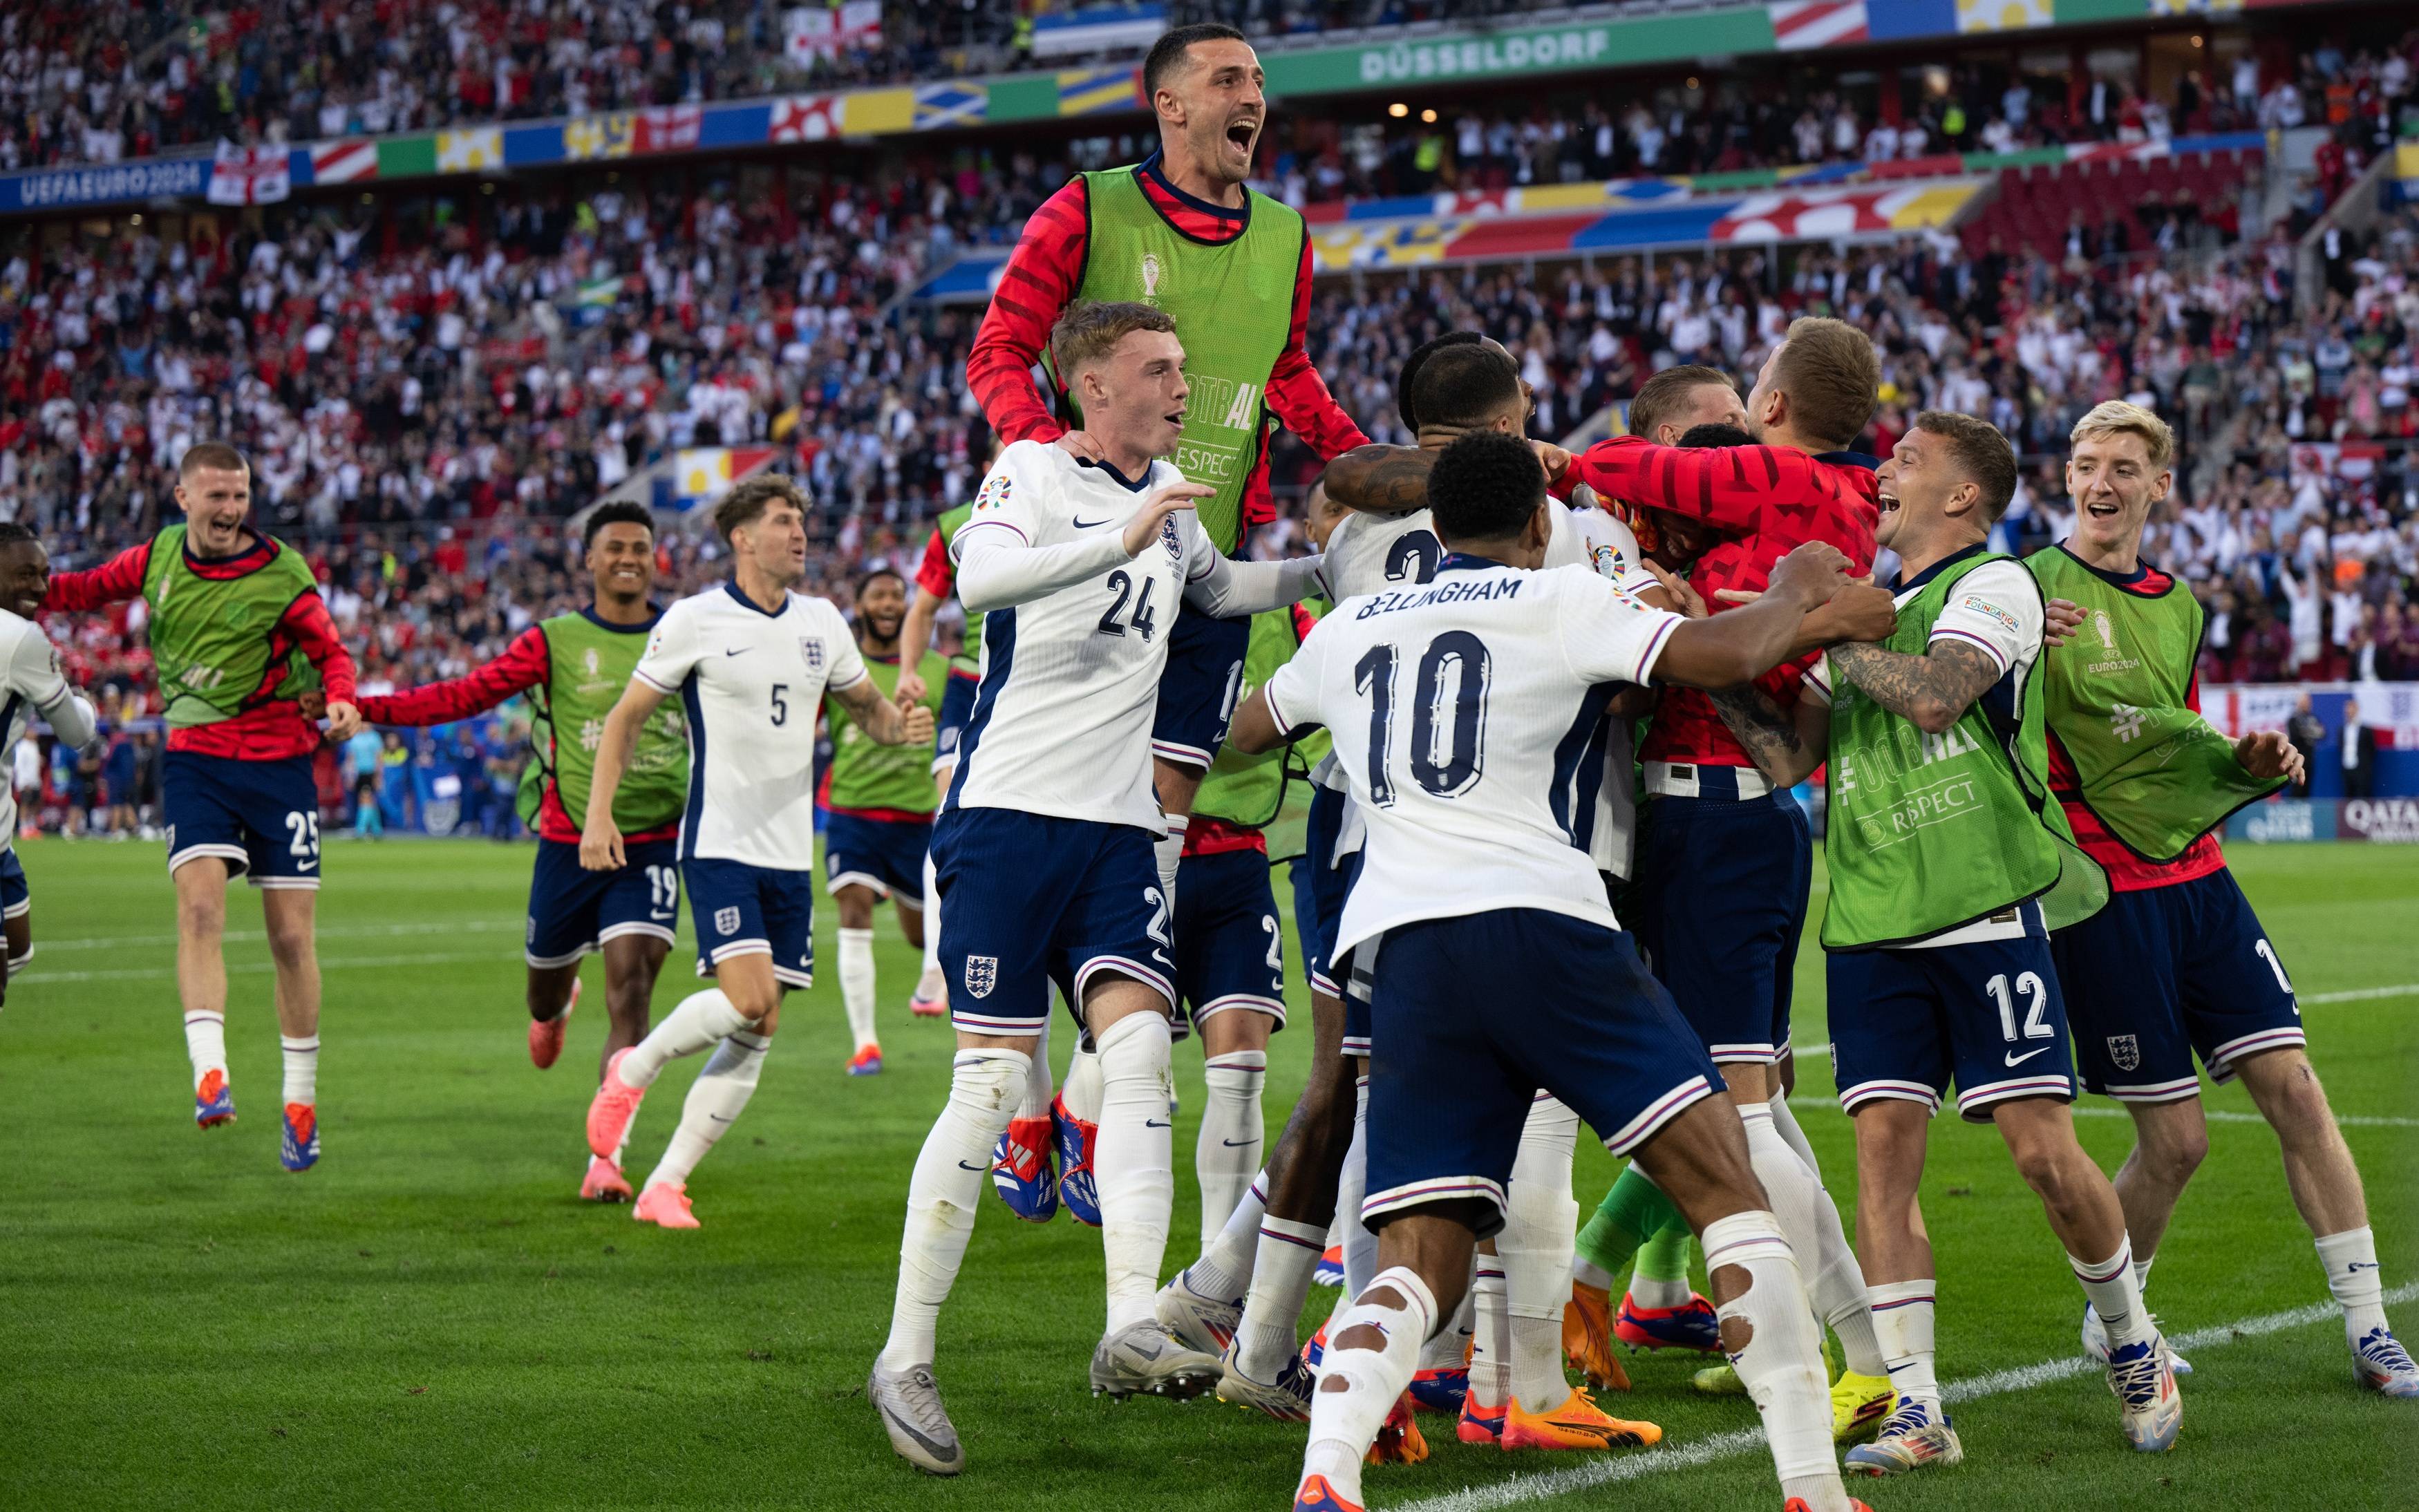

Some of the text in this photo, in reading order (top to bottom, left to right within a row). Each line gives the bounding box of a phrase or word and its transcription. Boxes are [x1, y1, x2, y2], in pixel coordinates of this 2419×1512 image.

[1359, 30, 1609, 82] DÜSSELDORF
[1098, 570, 1156, 643] 24
[1355, 578, 1523, 621] BELLINGHAM
[1965, 599, 2020, 629] FOUNDATION
[2088, 658, 2140, 673] EURO2024
[771, 683, 789, 727] 5
[1355, 630, 1491, 809] 10
[285, 811, 319, 856] 25
[645, 864, 677, 909] 19
[1986, 971, 2054, 1041] 12
